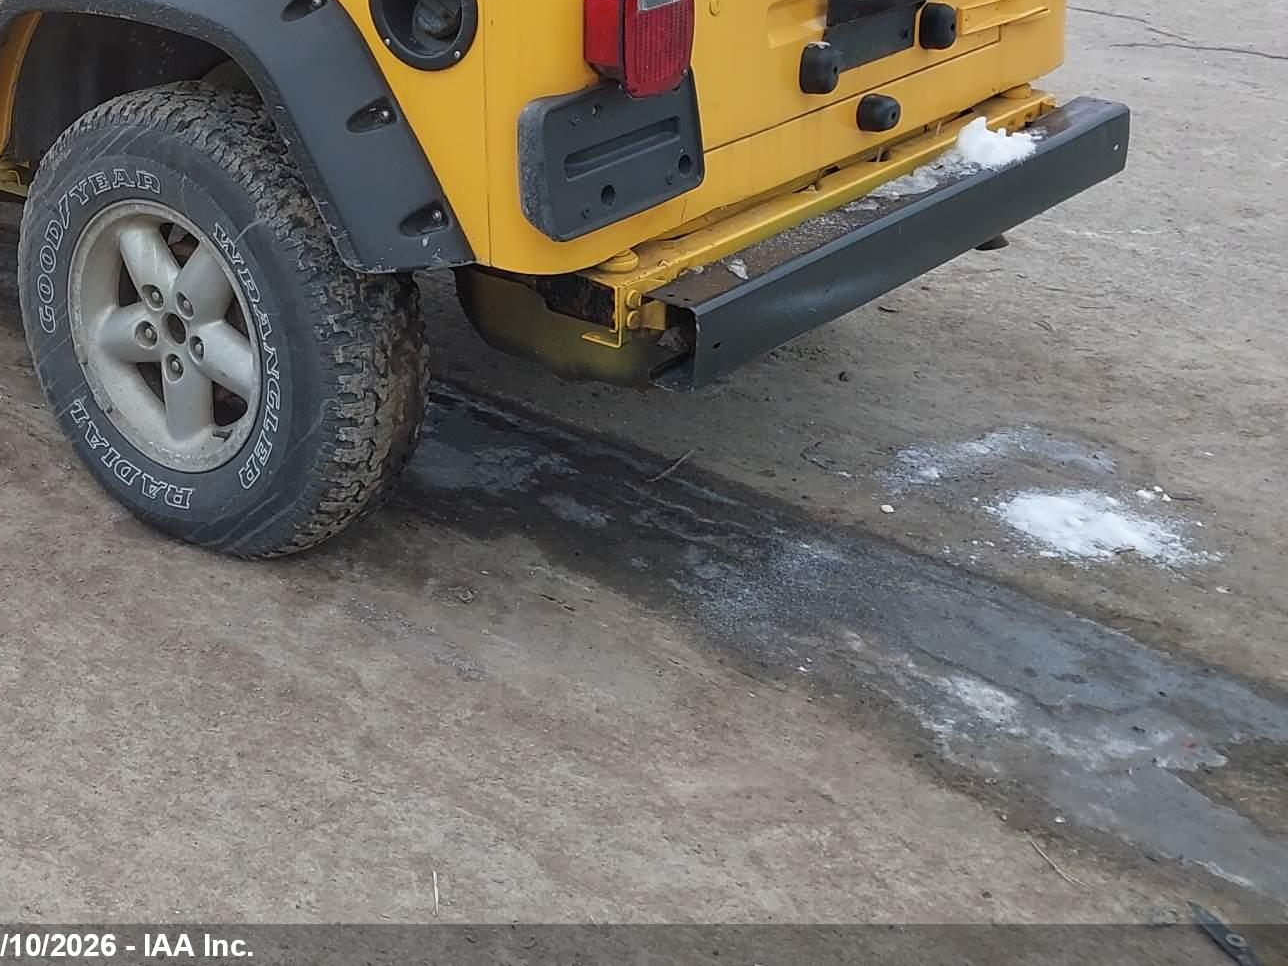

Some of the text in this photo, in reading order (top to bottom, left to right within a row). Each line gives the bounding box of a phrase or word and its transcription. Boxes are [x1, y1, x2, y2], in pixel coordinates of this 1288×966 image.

[37, 169, 162, 334] GOODYEAR
[213, 222, 281, 490] WRANGLER
[70, 398, 196, 509] RADIAL
